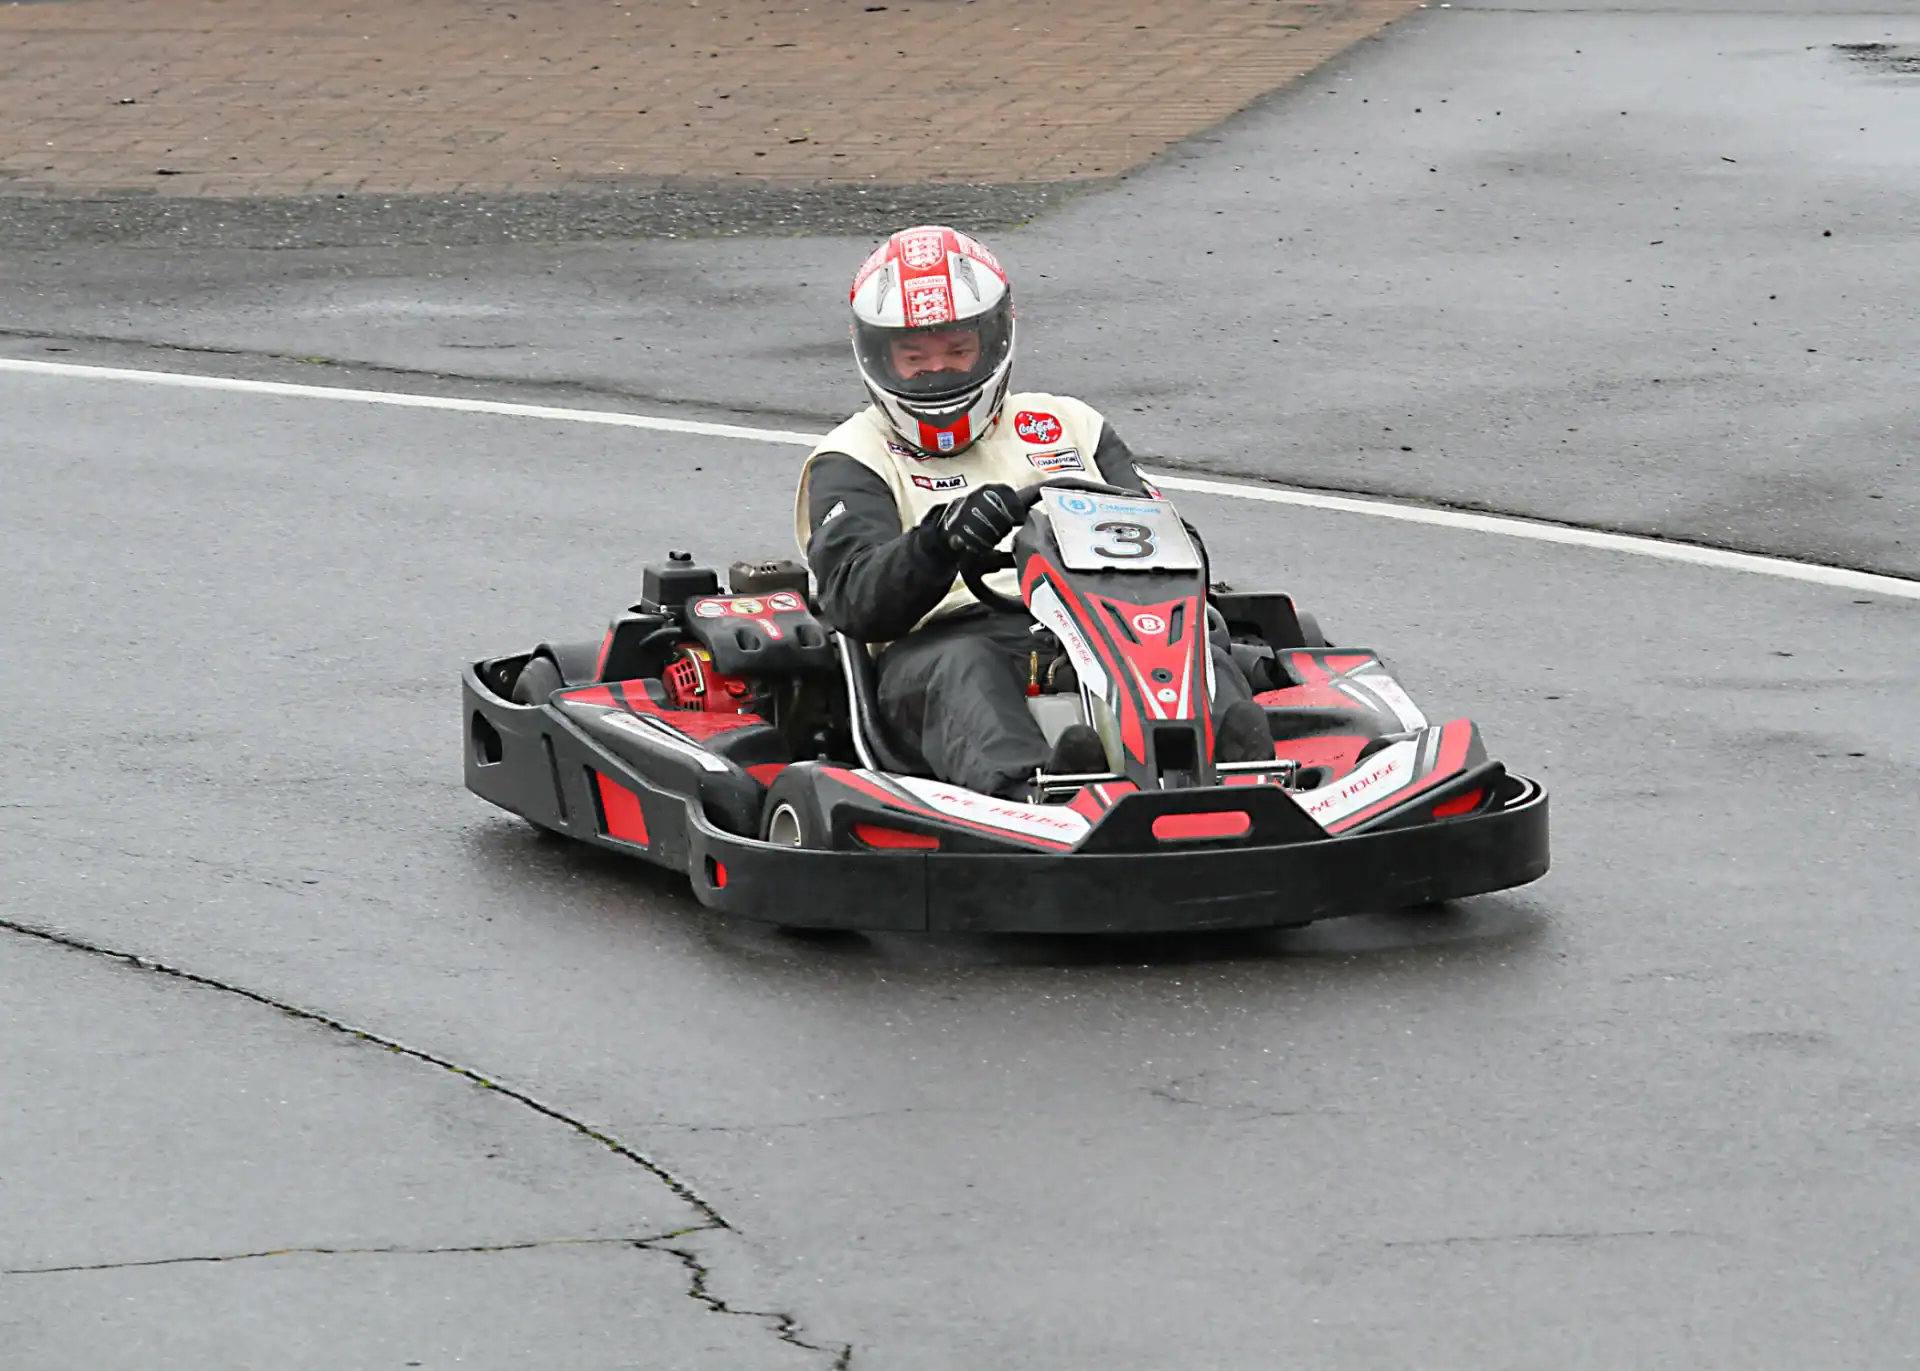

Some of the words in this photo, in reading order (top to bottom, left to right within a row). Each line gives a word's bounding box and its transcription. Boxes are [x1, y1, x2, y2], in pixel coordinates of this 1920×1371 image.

[1037, 456, 1078, 466] CHAMPION
[1094, 521, 1155, 559] 3
[1341, 761, 1400, 799] HOUSE
